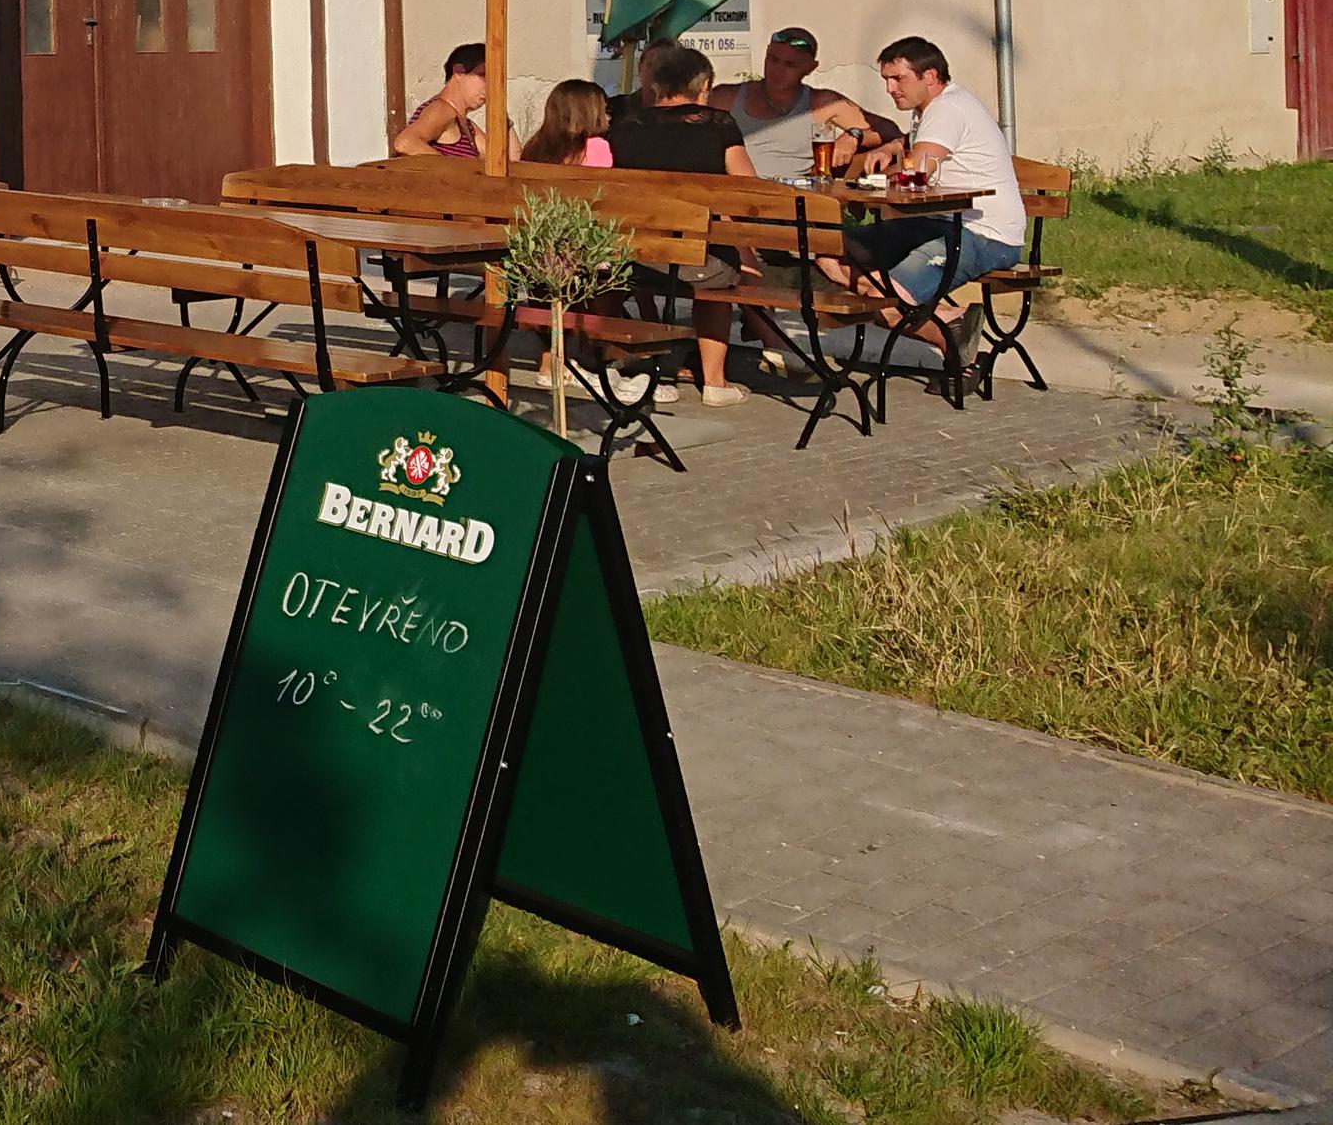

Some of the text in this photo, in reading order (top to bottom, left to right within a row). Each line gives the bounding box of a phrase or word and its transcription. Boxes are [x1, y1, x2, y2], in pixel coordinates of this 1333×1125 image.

[698, 38, 715, 50] 761
[718, 38, 735, 50] 056
[317, 482, 495, 564] BERNARD
[283, 572, 468, 653] OTEVŘENO
